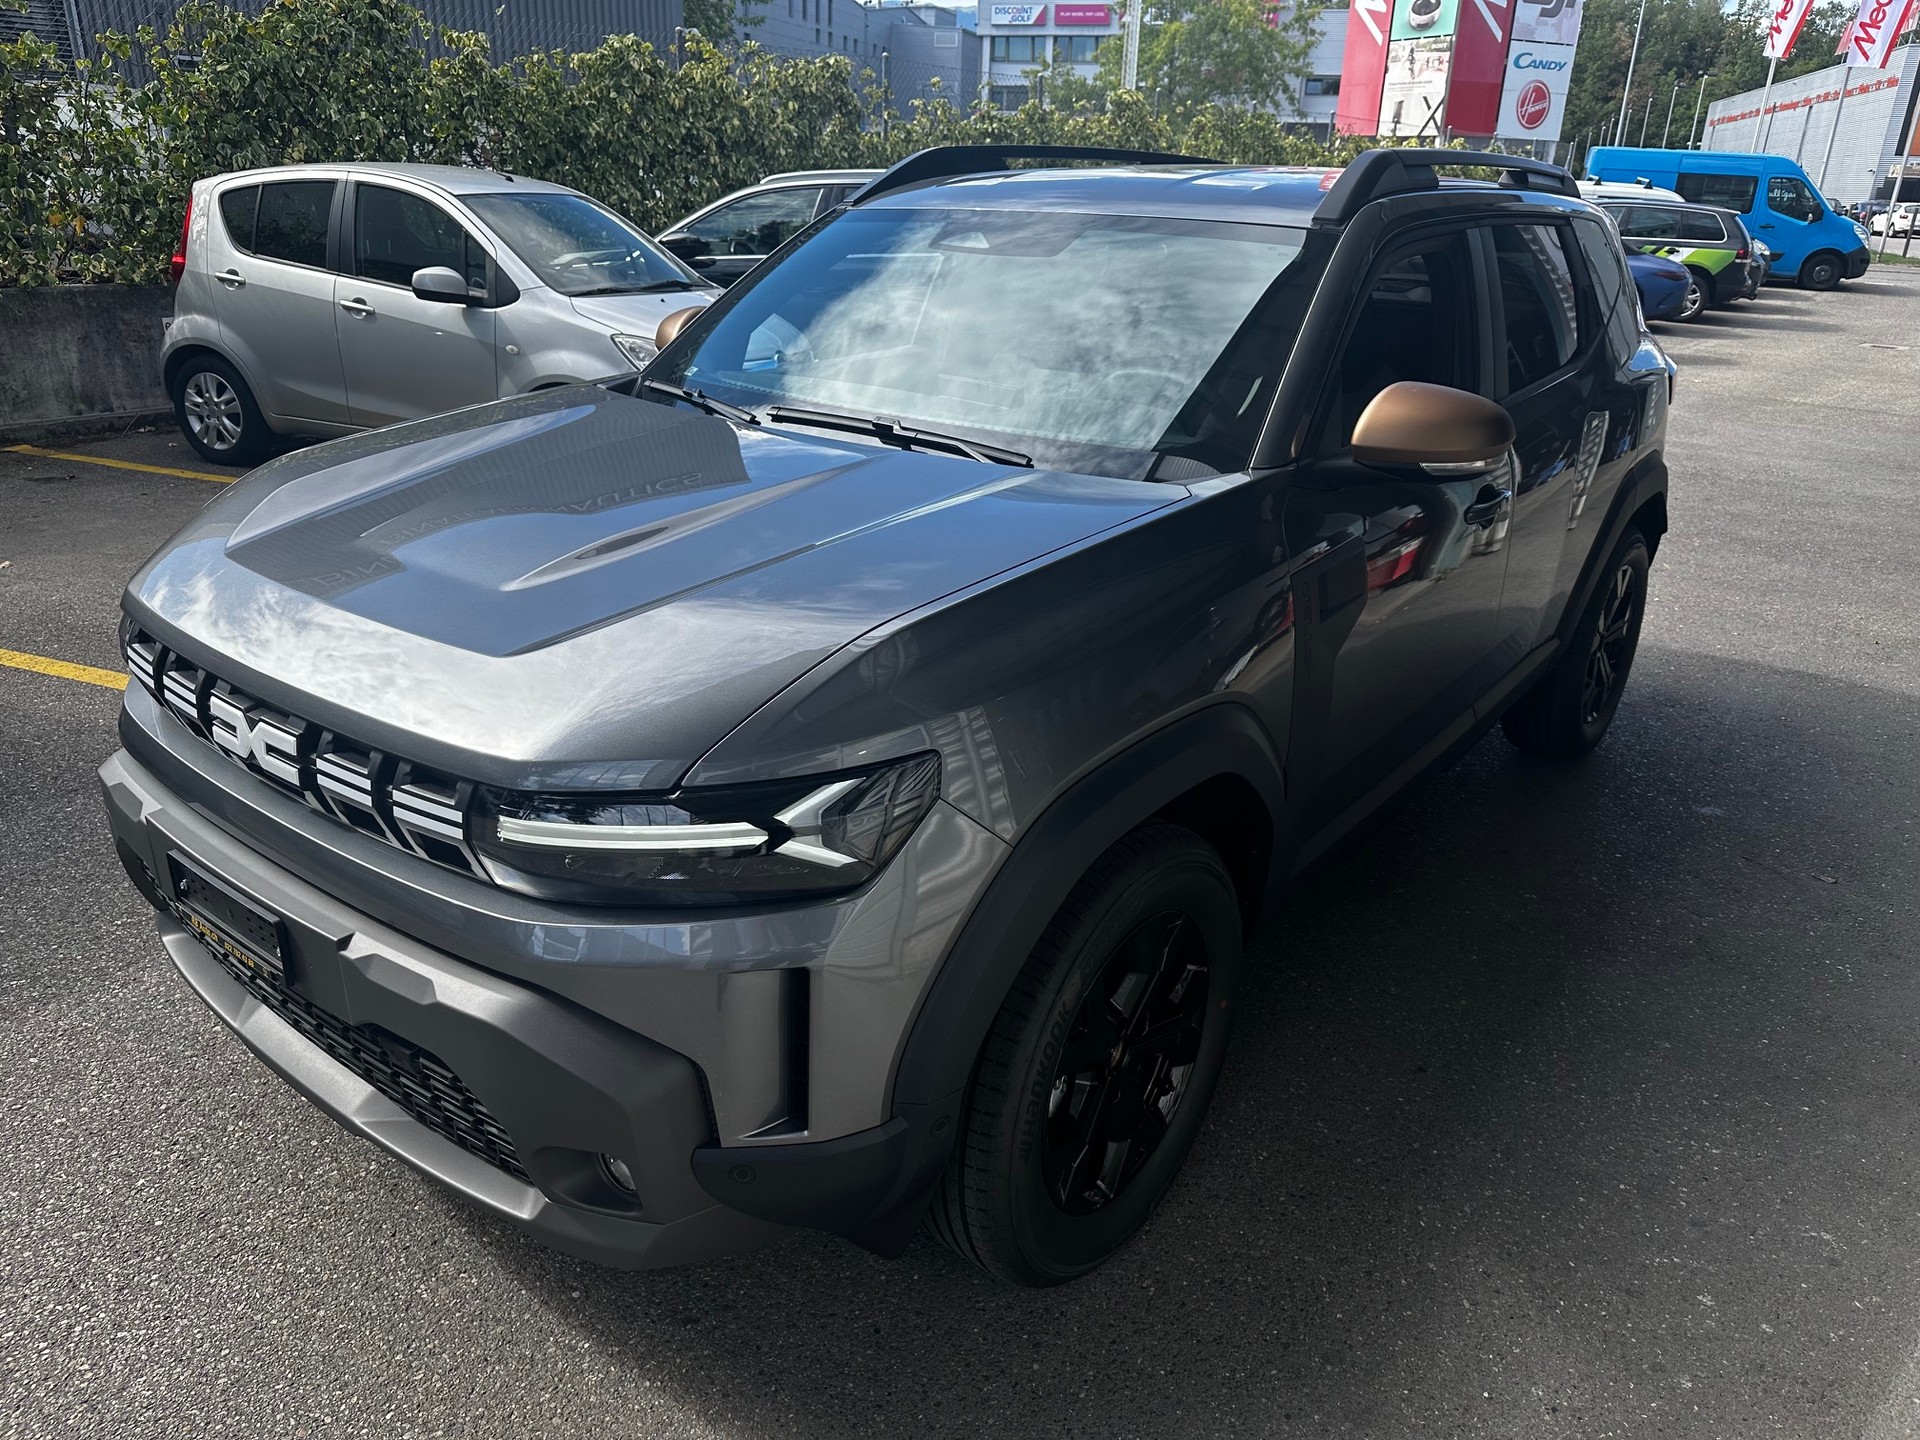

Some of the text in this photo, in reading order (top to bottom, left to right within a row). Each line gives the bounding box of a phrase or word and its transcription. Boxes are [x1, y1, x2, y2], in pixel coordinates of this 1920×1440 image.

[994, 6, 1033, 15] DISCOUNT
[1011, 14, 1032, 22] GOLF
[1513, 52, 1568, 72] CANDY
